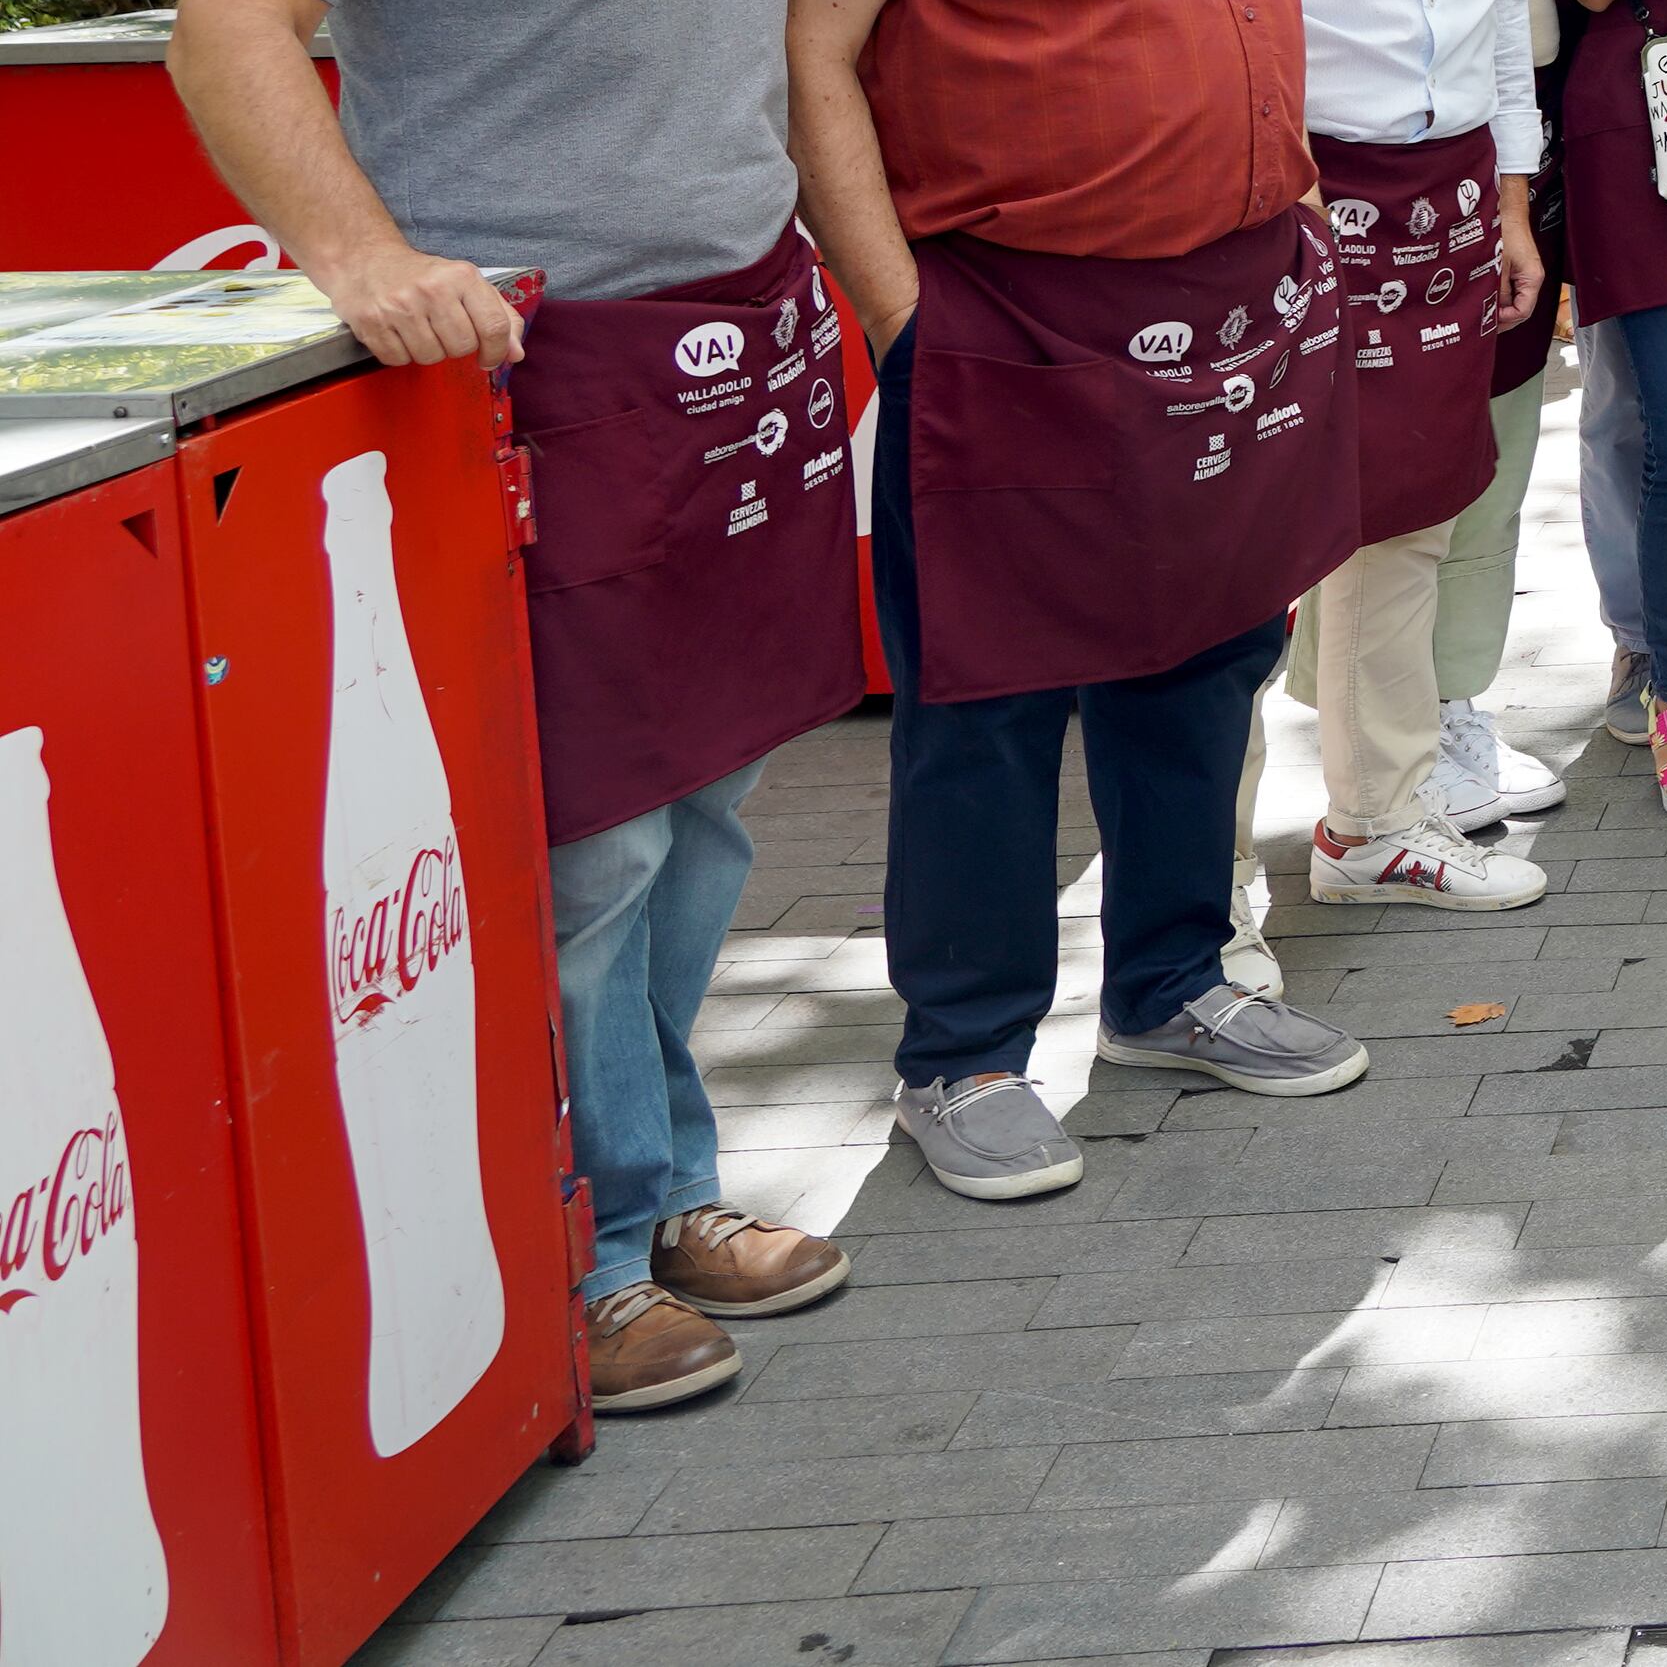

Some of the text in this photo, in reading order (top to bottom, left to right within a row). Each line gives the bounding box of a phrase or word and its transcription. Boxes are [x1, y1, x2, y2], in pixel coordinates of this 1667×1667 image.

[1393, 250, 1439, 266] Valladolid
[1139, 334, 1182, 354] VA!
[1420, 322, 1460, 343] Mahou
[682, 335, 734, 367] VA!
[1357, 346, 1392, 358] CERVEZAS
[767, 357, 807, 392] Valladolid
[678, 377, 752, 404] VALLADOLID
[687, 395, 745, 415] ciudad amiga
[1256, 403, 1302, 432] Mahou
[1257, 425, 1282, 441] DESDE
[804, 446, 843, 480] Mahou
[1197, 448, 1232, 469] CERVEZAS
[730, 497, 767, 522] CERVEZAS
[727, 510, 768, 537] ALHAMBRA
[332, 835, 464, 1024] Coca-Cola
[0, 1111, 129, 1315] a-Cola
